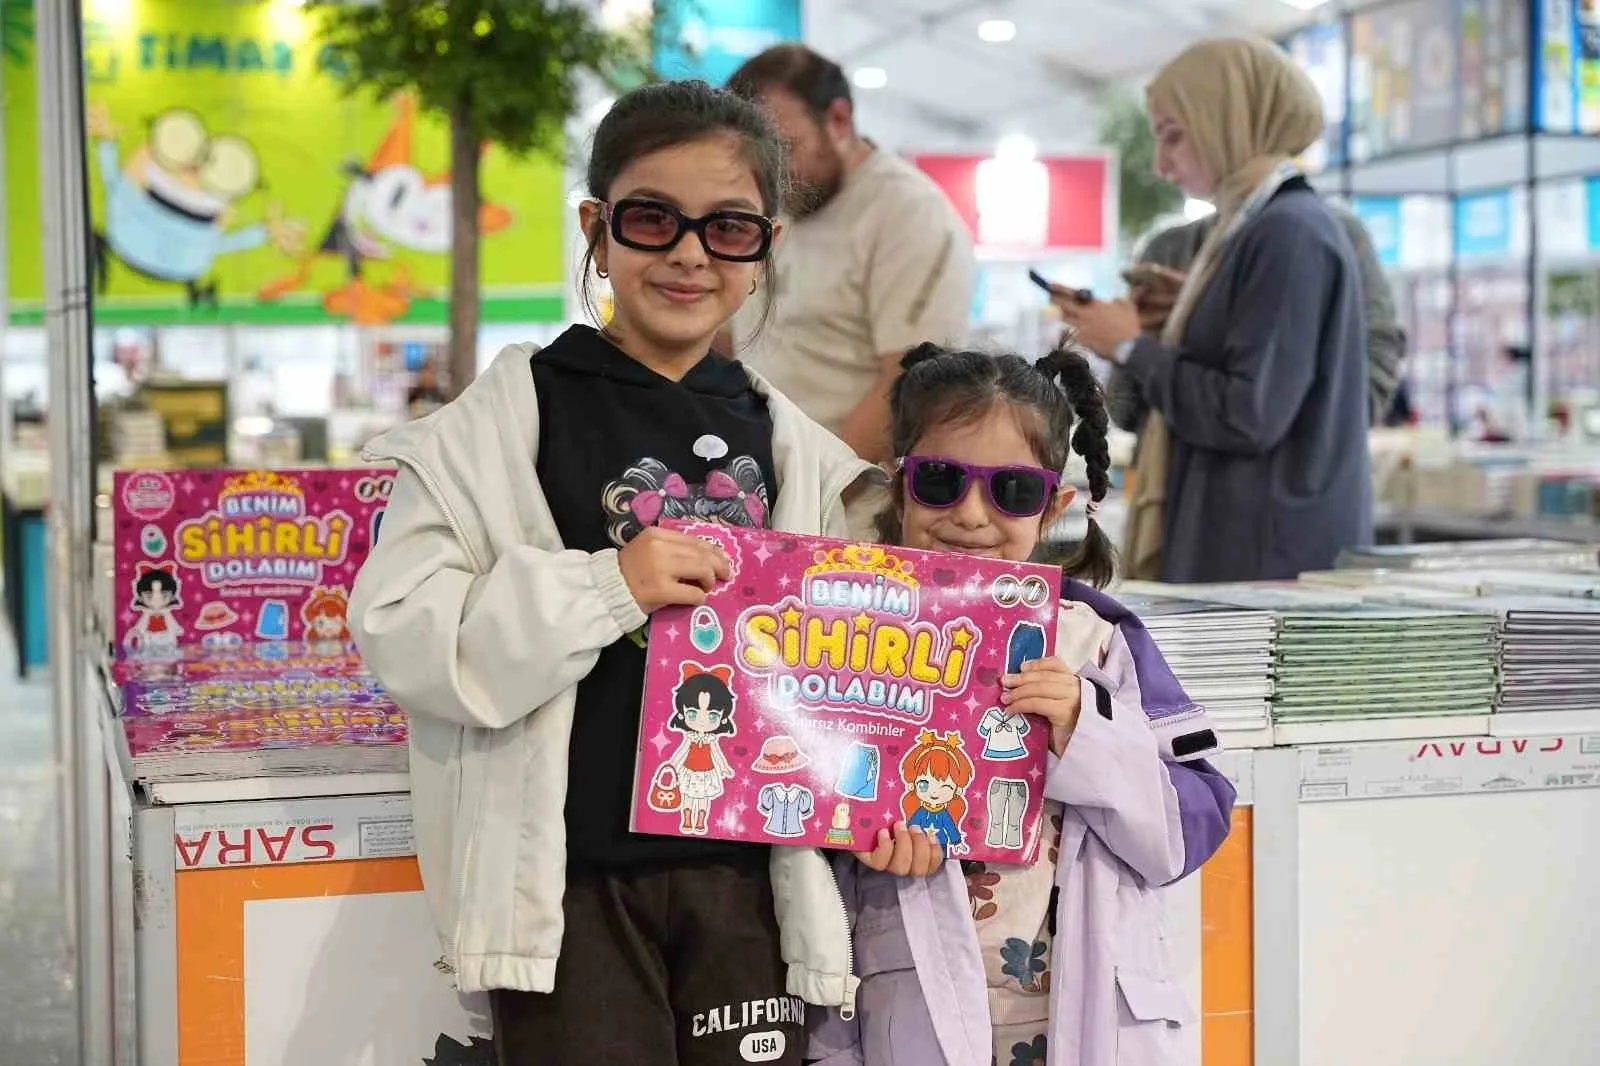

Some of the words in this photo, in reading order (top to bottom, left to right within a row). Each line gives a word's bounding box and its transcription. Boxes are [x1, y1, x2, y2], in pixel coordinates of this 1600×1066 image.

[181, 516, 345, 562] SİHİRLİ
[208, 560, 316, 580] DOLABIM
[811, 575, 911, 616] BENİM
[742, 605, 975, 689] SİHİRLİ
[776, 673, 925, 716] DOLABIM
[837, 718, 905, 738] Kombinler
[752, 1038, 778, 1054] USA
